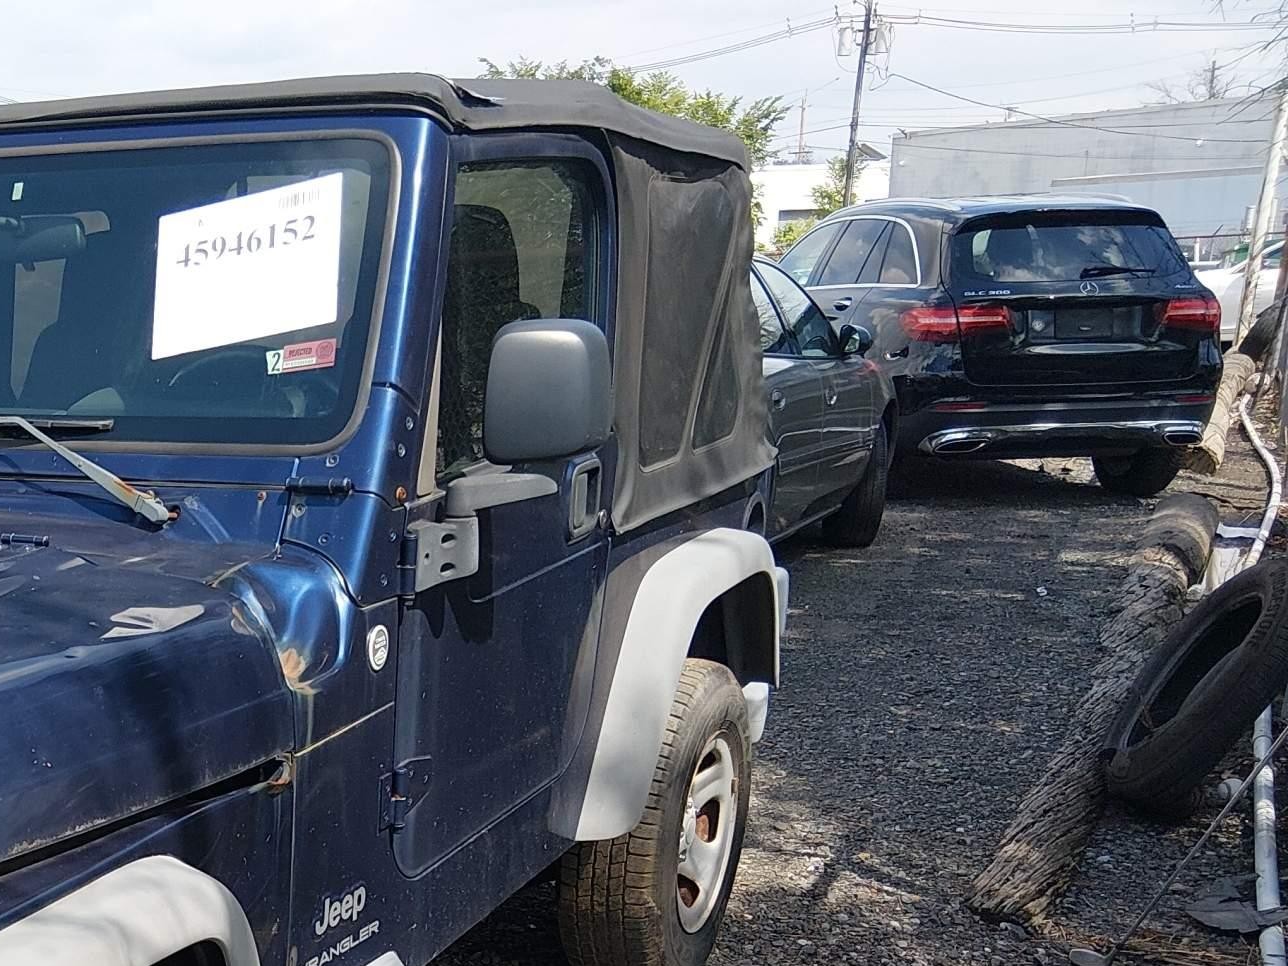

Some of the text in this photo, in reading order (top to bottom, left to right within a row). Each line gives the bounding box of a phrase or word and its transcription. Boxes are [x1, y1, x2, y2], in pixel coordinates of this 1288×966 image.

[176, 214, 316, 268] 45946152
[271, 352, 281, 372] 2
[315, 886, 366, 935] Jeep
